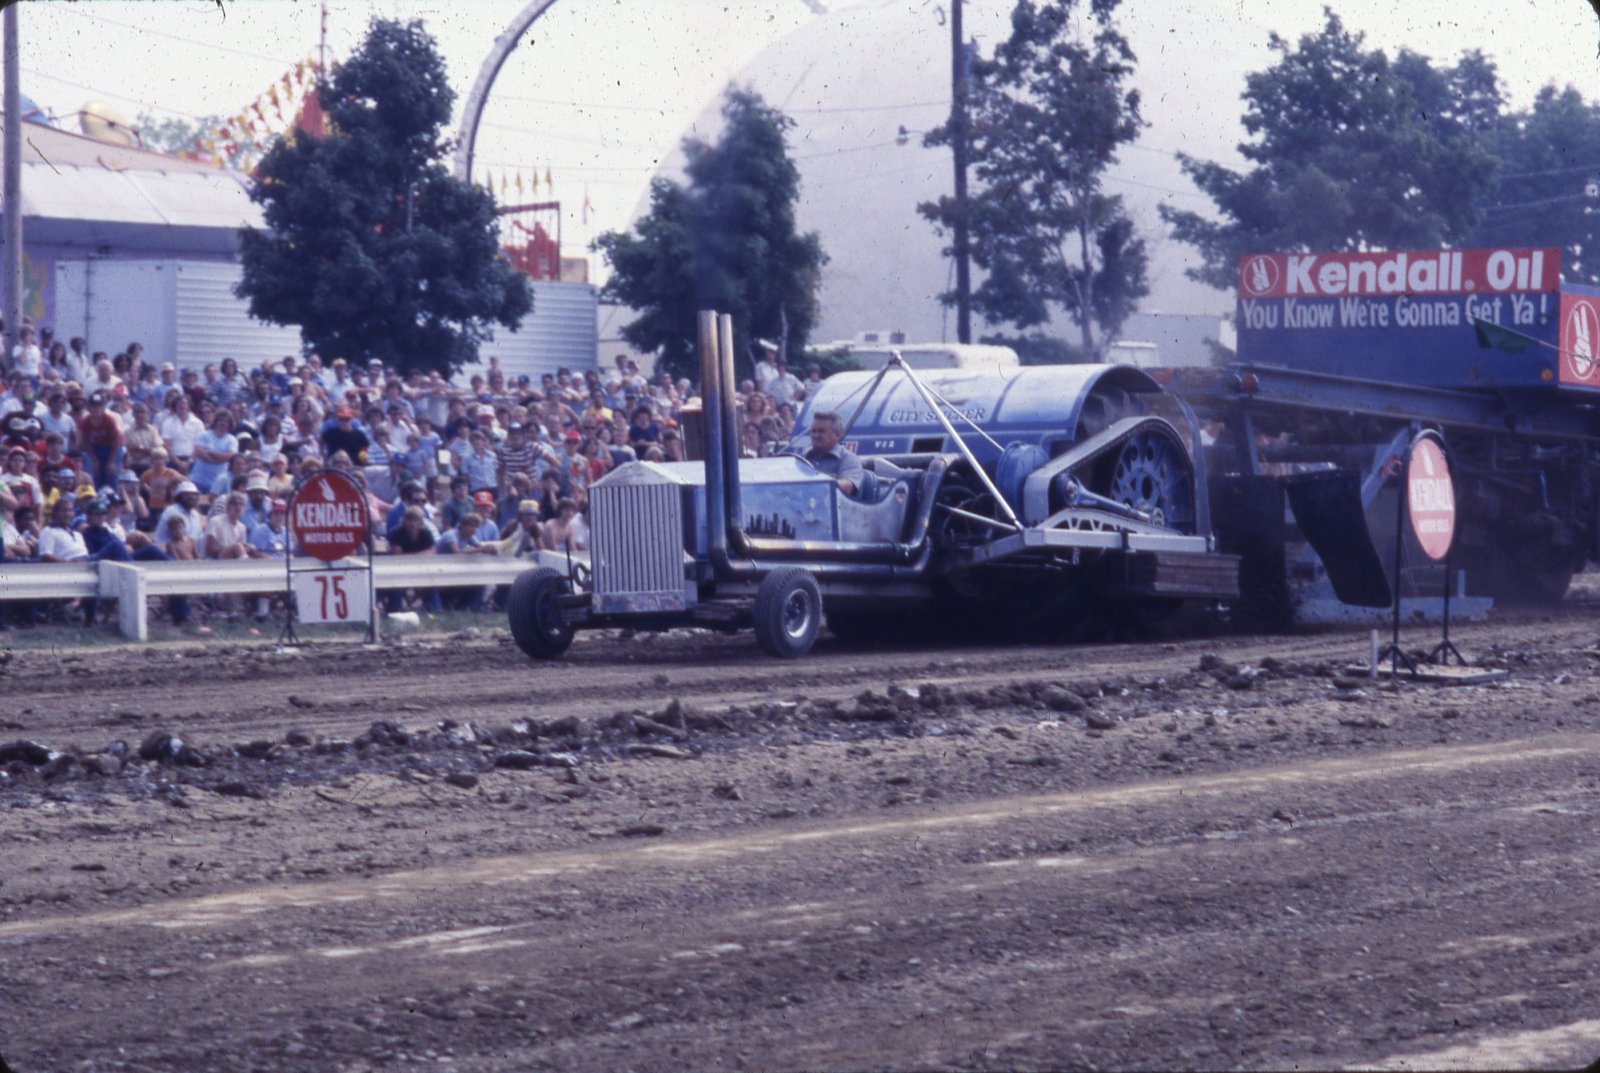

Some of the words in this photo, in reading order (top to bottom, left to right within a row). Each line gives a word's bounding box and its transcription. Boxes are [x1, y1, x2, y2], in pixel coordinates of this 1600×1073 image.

[1486, 250, 1544, 290] Oil
[1242, 298, 1278, 329] You
[1283, 297, 1334, 328] Know
[1339, 297, 1389, 327] We're
[1395, 295, 1460, 326] Gonna
[1465, 293, 1502, 325] Get
[889, 410, 920, 422] CITY
[296, 503, 362, 527] KENDALL
[304, 534, 333, 543] MOTOR
[334, 532, 354, 543] OILS
[314, 575, 349, 620] 75
